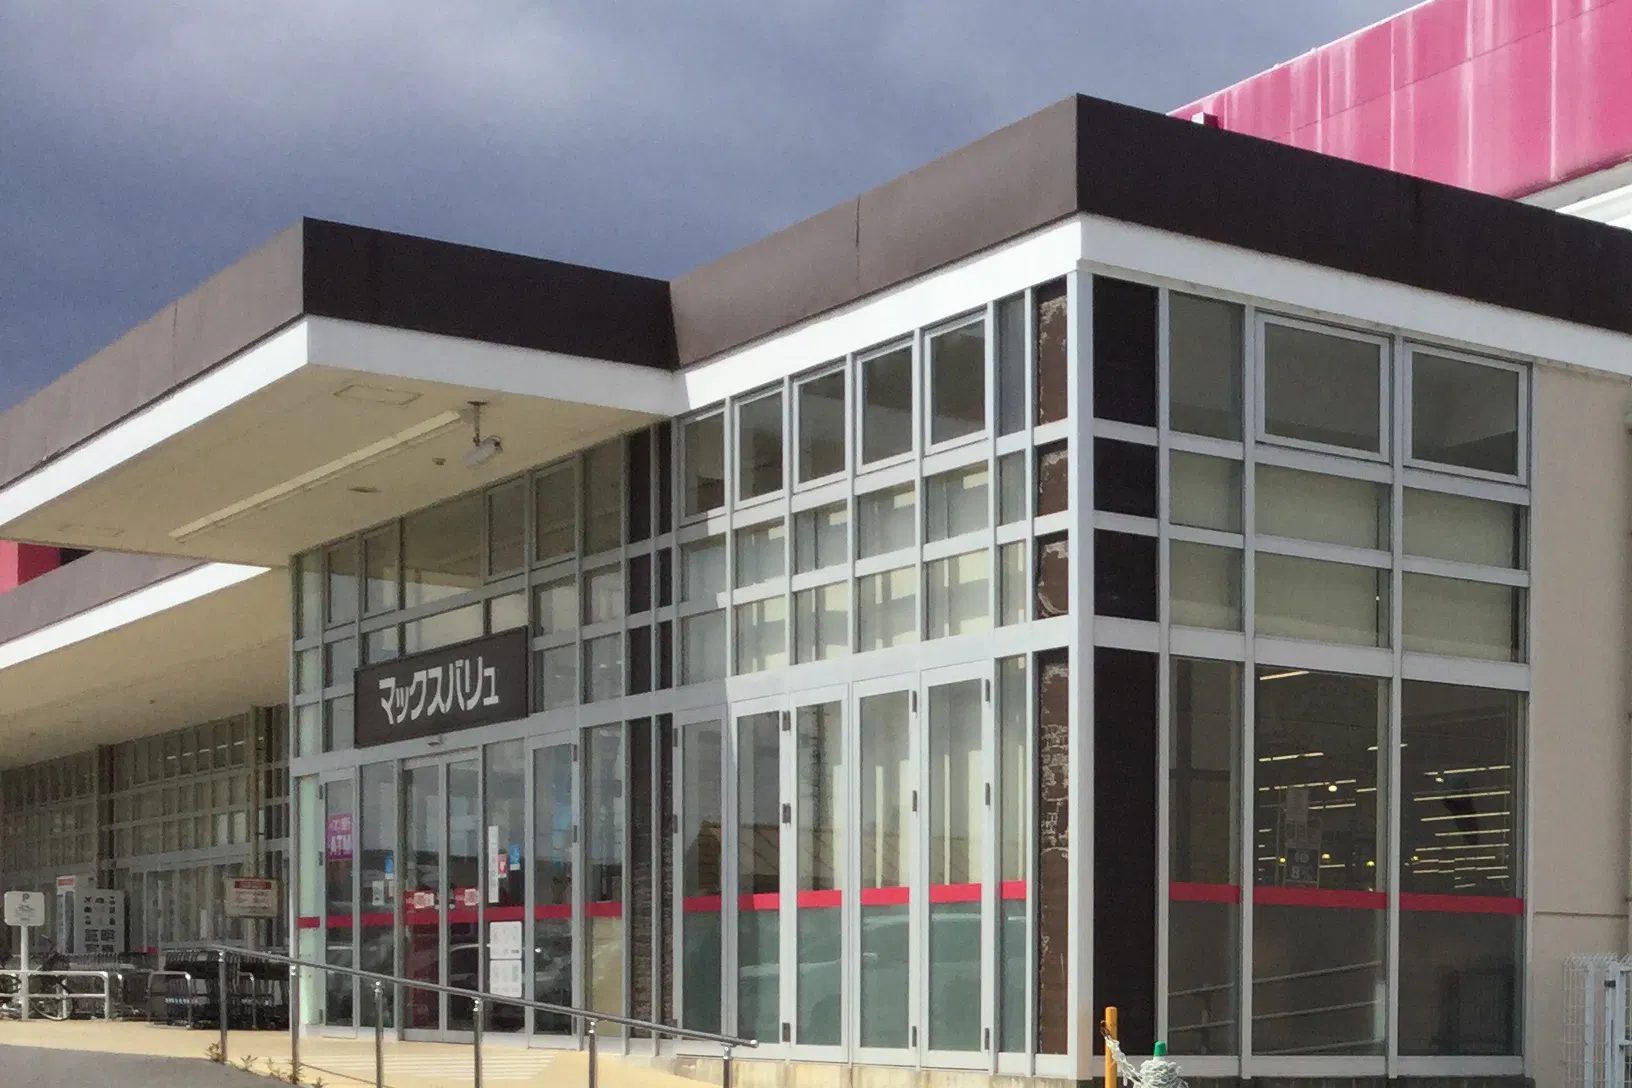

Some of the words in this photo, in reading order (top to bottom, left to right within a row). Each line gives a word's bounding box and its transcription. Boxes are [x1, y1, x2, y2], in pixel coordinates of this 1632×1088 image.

[378, 656, 500, 725] マックスバリュ
[330, 834, 352, 855] ATM
